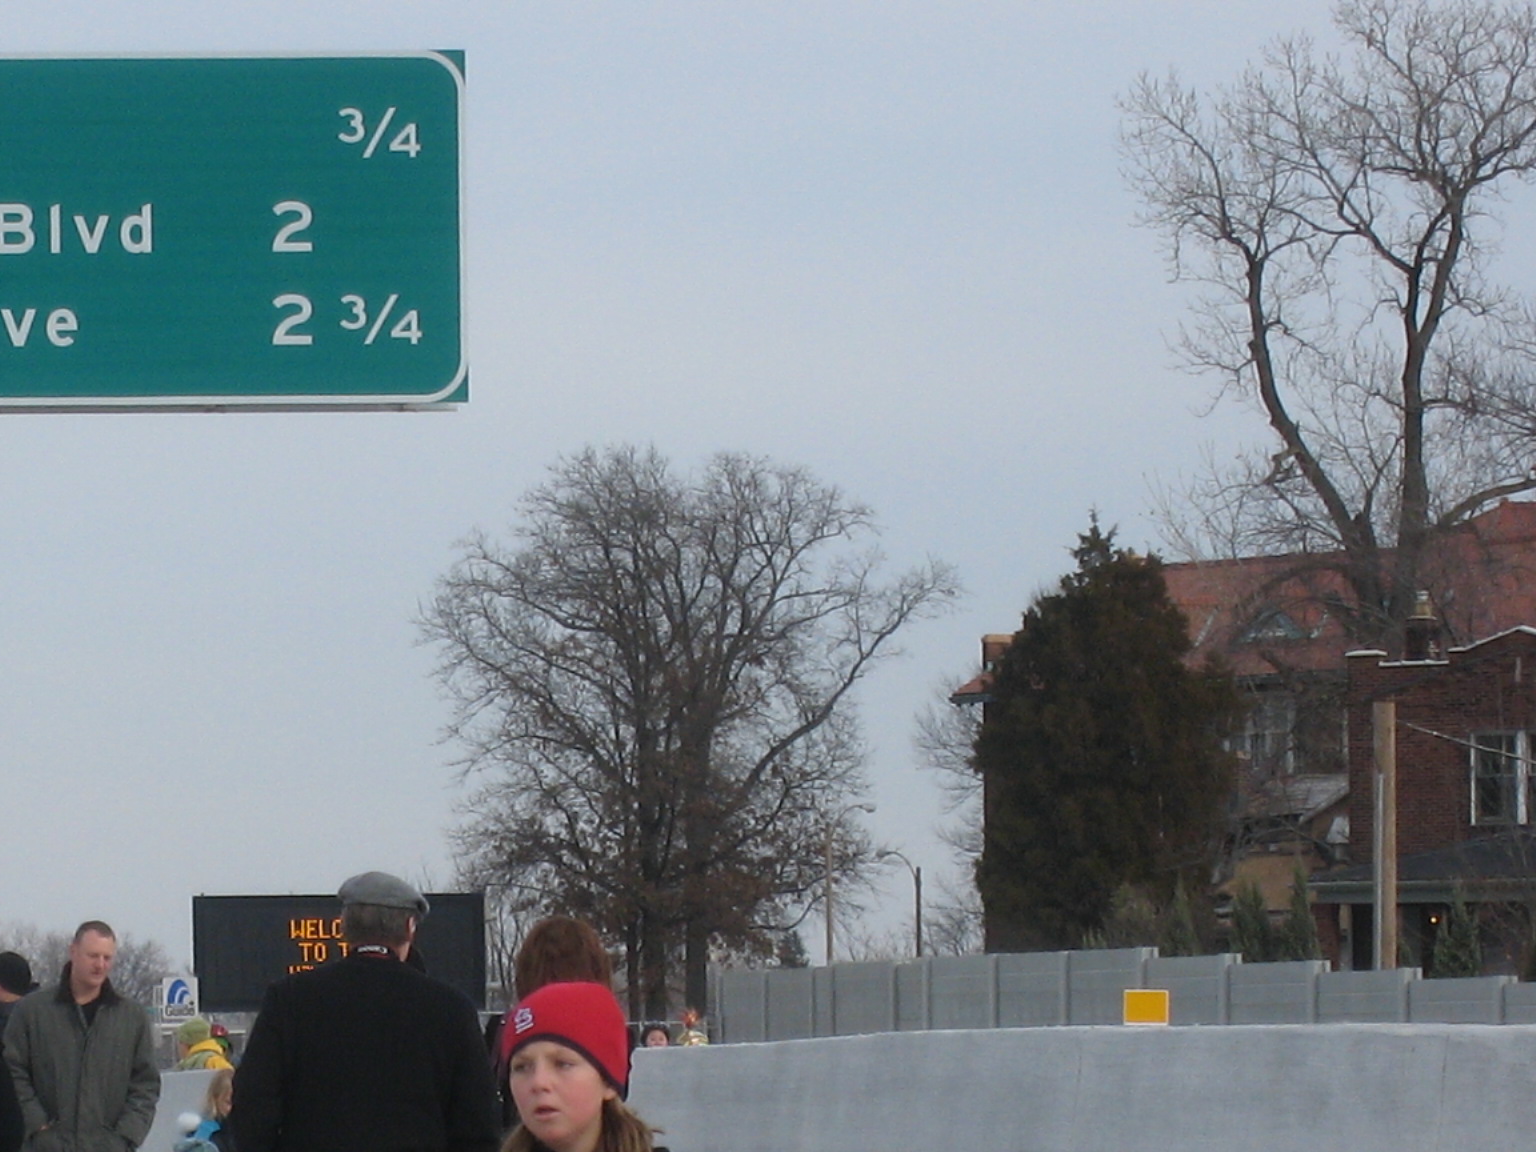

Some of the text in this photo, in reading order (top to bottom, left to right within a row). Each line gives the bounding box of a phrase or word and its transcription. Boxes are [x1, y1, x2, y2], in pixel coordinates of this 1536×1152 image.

[272, 200, 314, 253] 2
[272, 293, 314, 346] 2
[290, 918, 344, 940] WELC
[298, 941, 327, 962] TO
